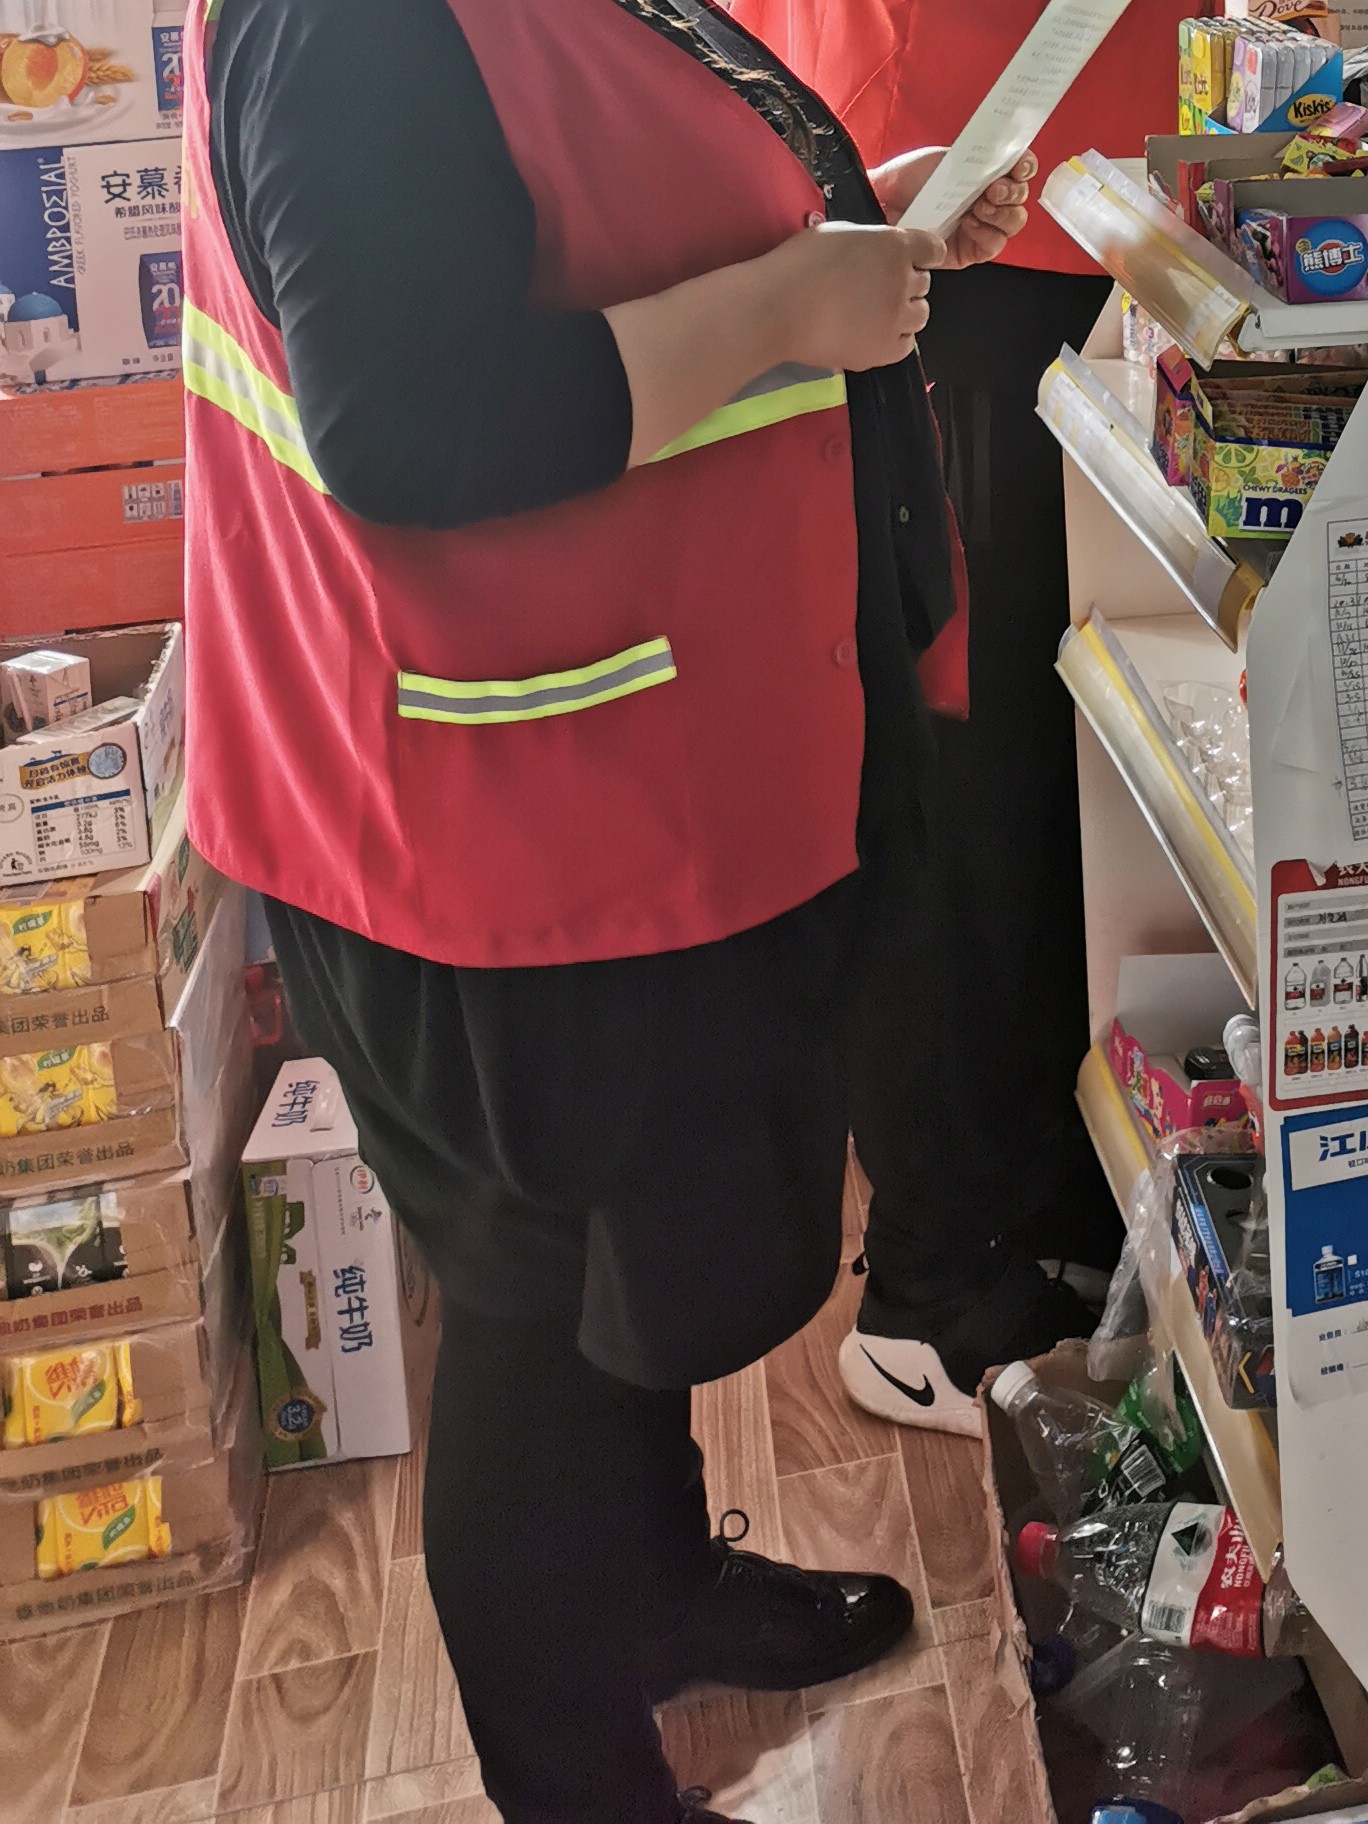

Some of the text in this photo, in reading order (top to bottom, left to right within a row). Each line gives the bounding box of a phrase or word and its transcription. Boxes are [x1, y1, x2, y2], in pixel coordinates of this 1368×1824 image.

[1293, 99, 1332, 119] Kiskis
[100, 166, 181, 204] 安慕
[1302, 238, 1366, 274] 熊博士
[1243, 483, 1270, 492] CHEWY
[271, 1080, 320, 1128] 纯牛奶
[333, 1266, 374, 1353] 纯牛奶
